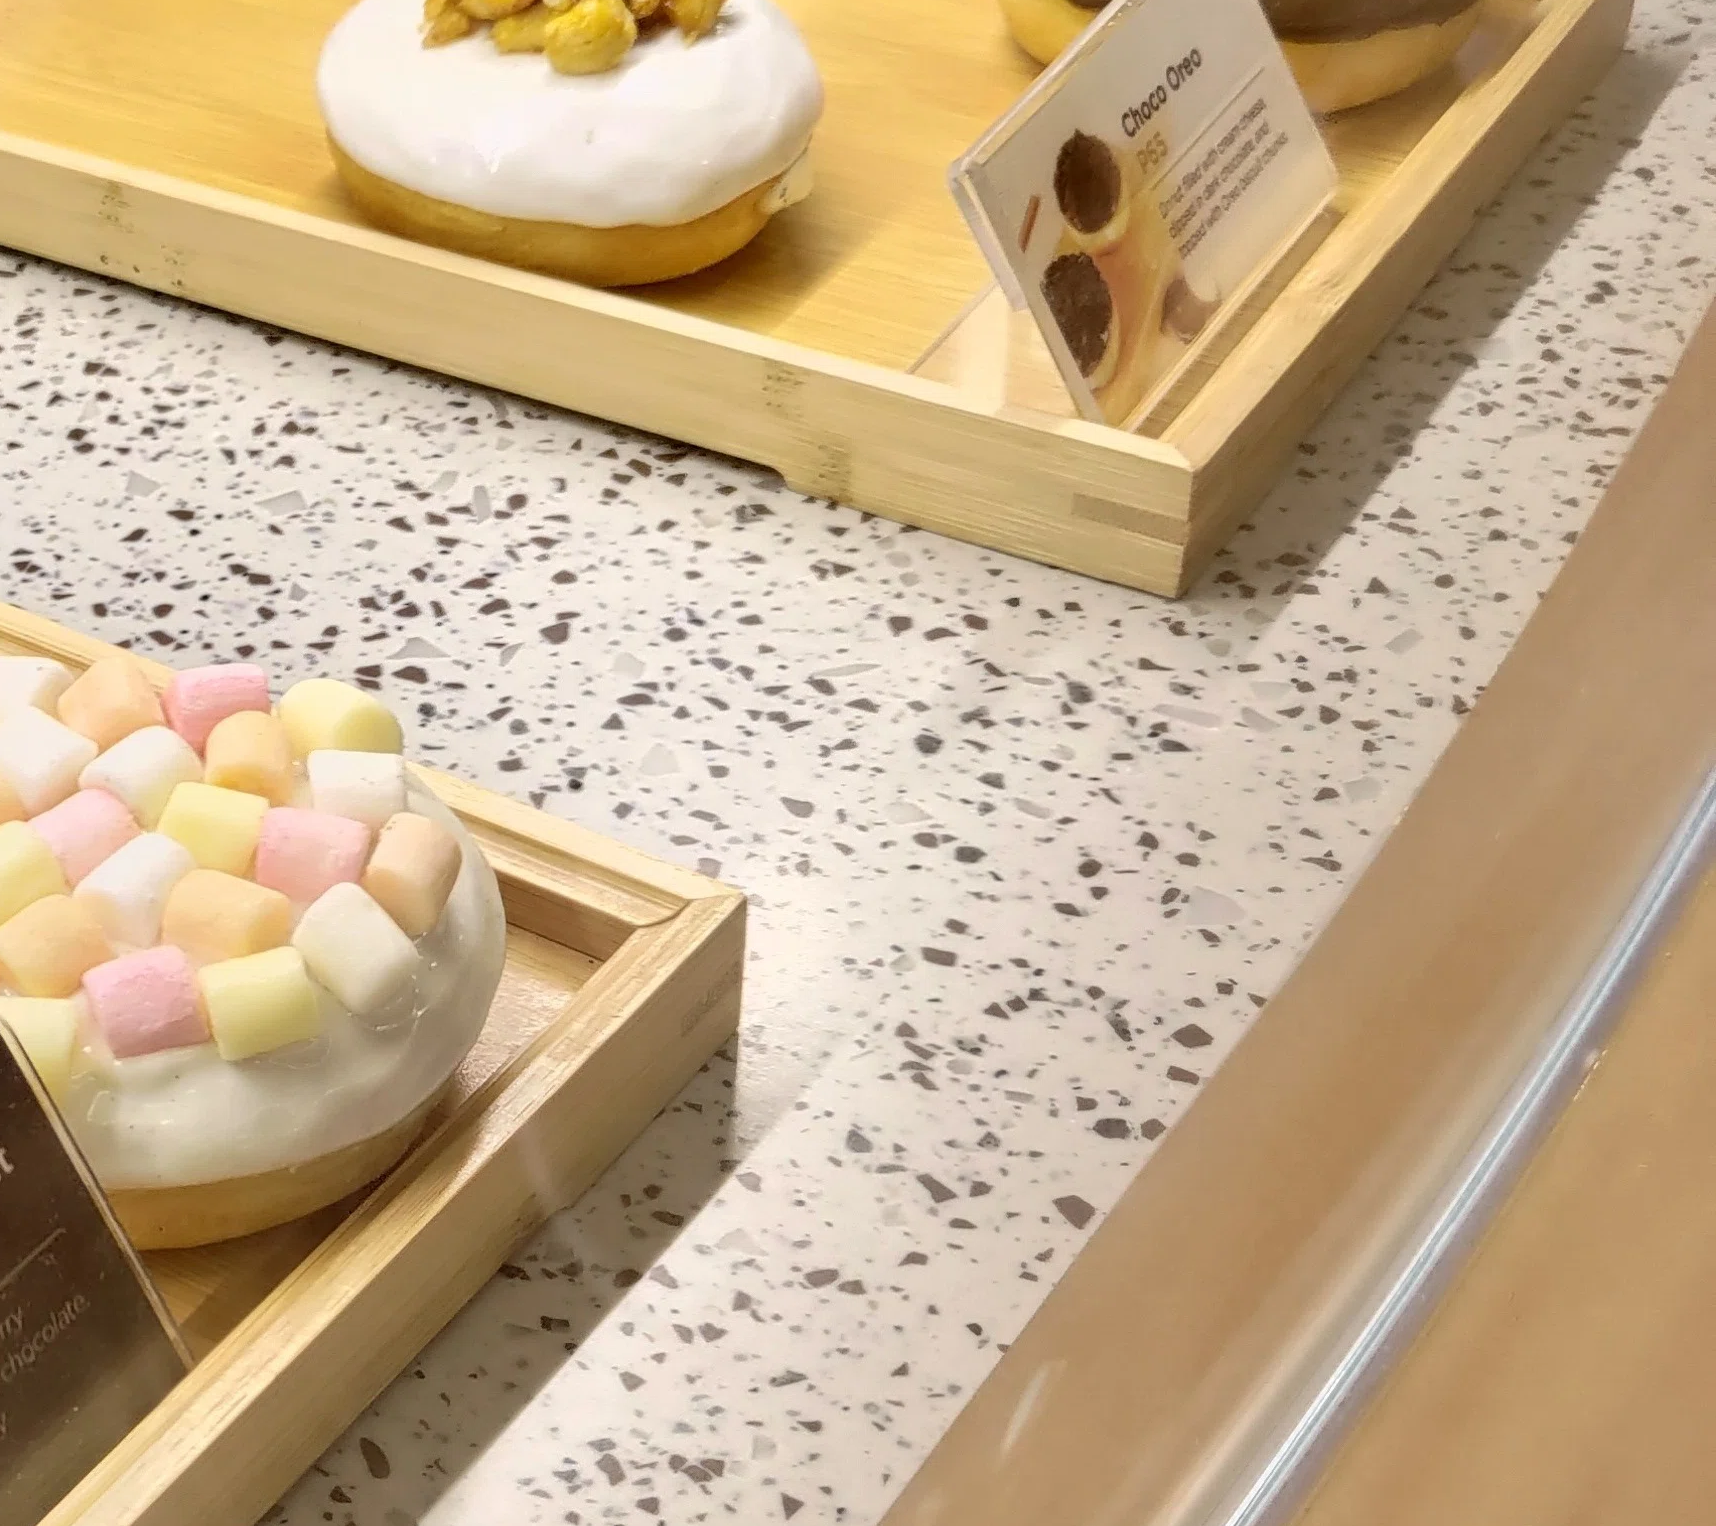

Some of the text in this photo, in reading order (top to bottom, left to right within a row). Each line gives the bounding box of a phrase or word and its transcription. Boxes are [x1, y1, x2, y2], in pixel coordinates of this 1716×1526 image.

[1121, 48, 1202, 138] Choco Oreo
[1136, 131, 1168, 174] P65
